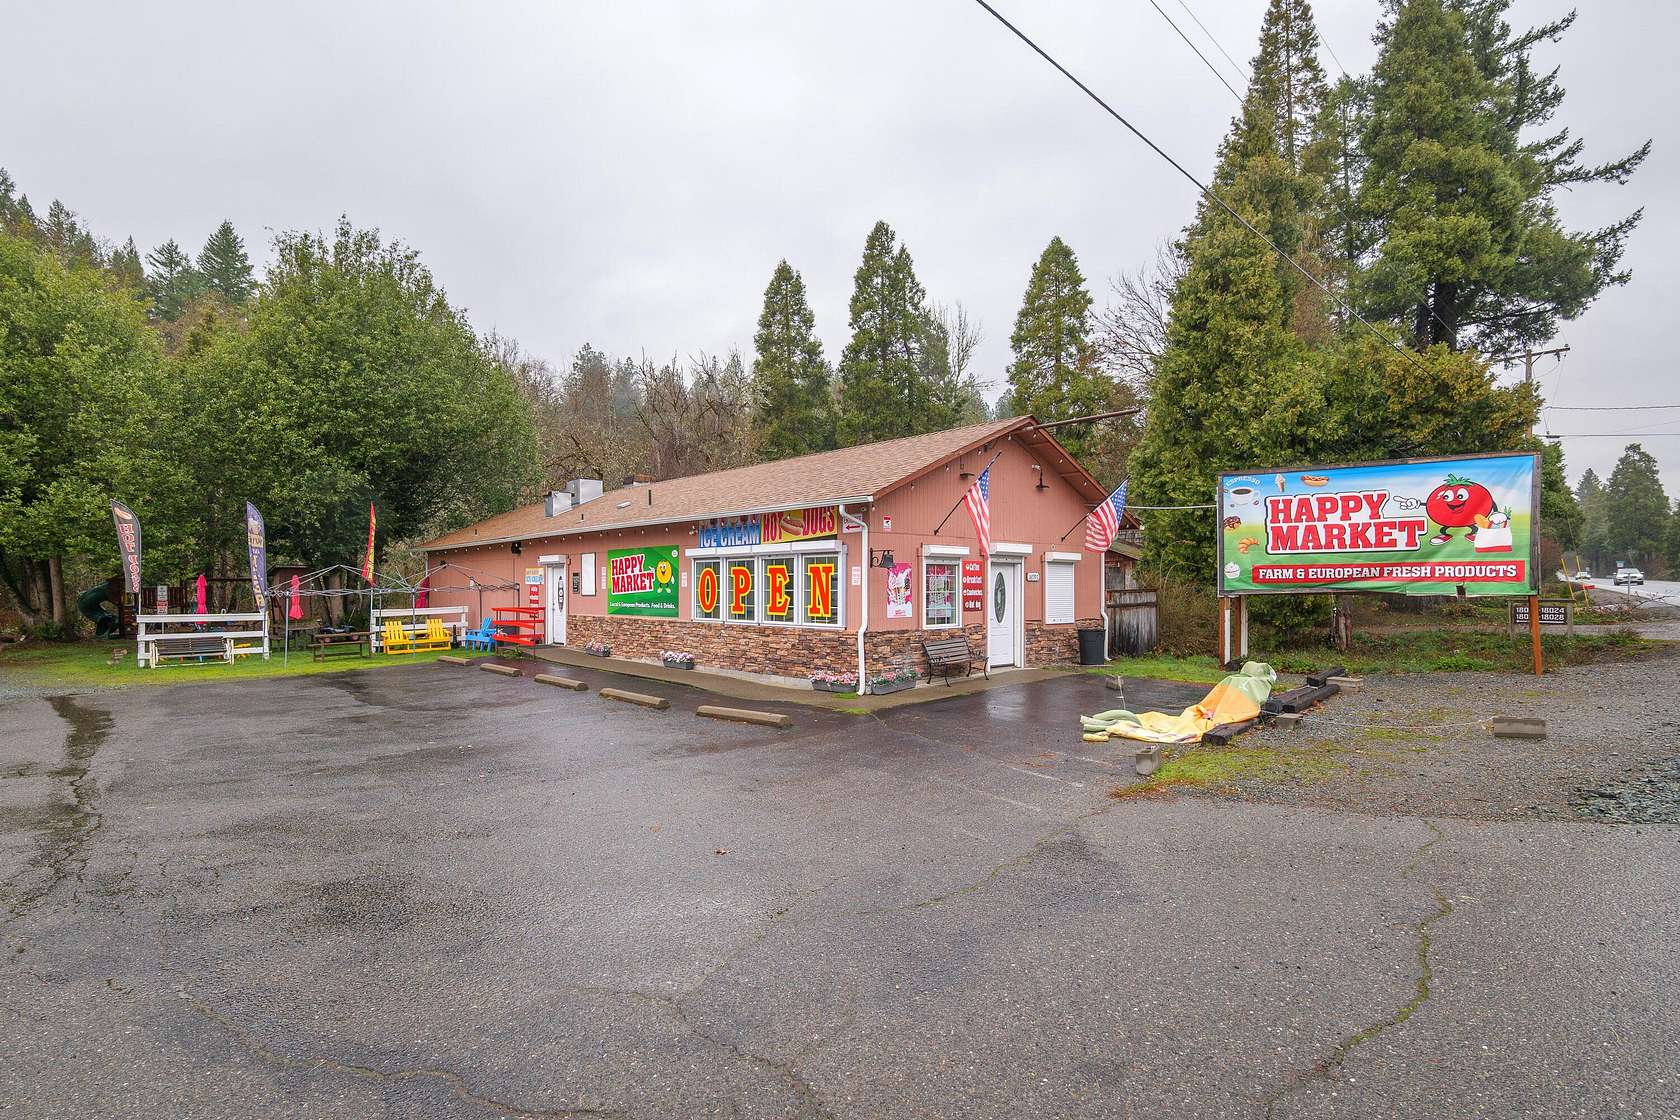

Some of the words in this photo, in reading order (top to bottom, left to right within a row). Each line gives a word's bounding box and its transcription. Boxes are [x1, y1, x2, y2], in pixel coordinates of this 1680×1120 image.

[1269, 493, 1387, 524] HAPPY
[700, 527, 718, 547] ICE
[719, 523, 760, 546] CREAM
[763, 511, 785, 542] HOT
[803, 506, 835, 537] DOGS
[1269, 519, 1426, 551] MARKET
[611, 554, 644, 576] HAPPY
[1258, 568, 1294, 580] FARM
[1296, 568, 1305, 579] &
[1308, 566, 1381, 579] EUROPEAN
[1383, 566, 1432, 578] FRESH
[1434, 564, 1518, 578] PRODUCTS
[611, 572, 655, 594] MARKET
[698, 563, 835, 618] OPEN
